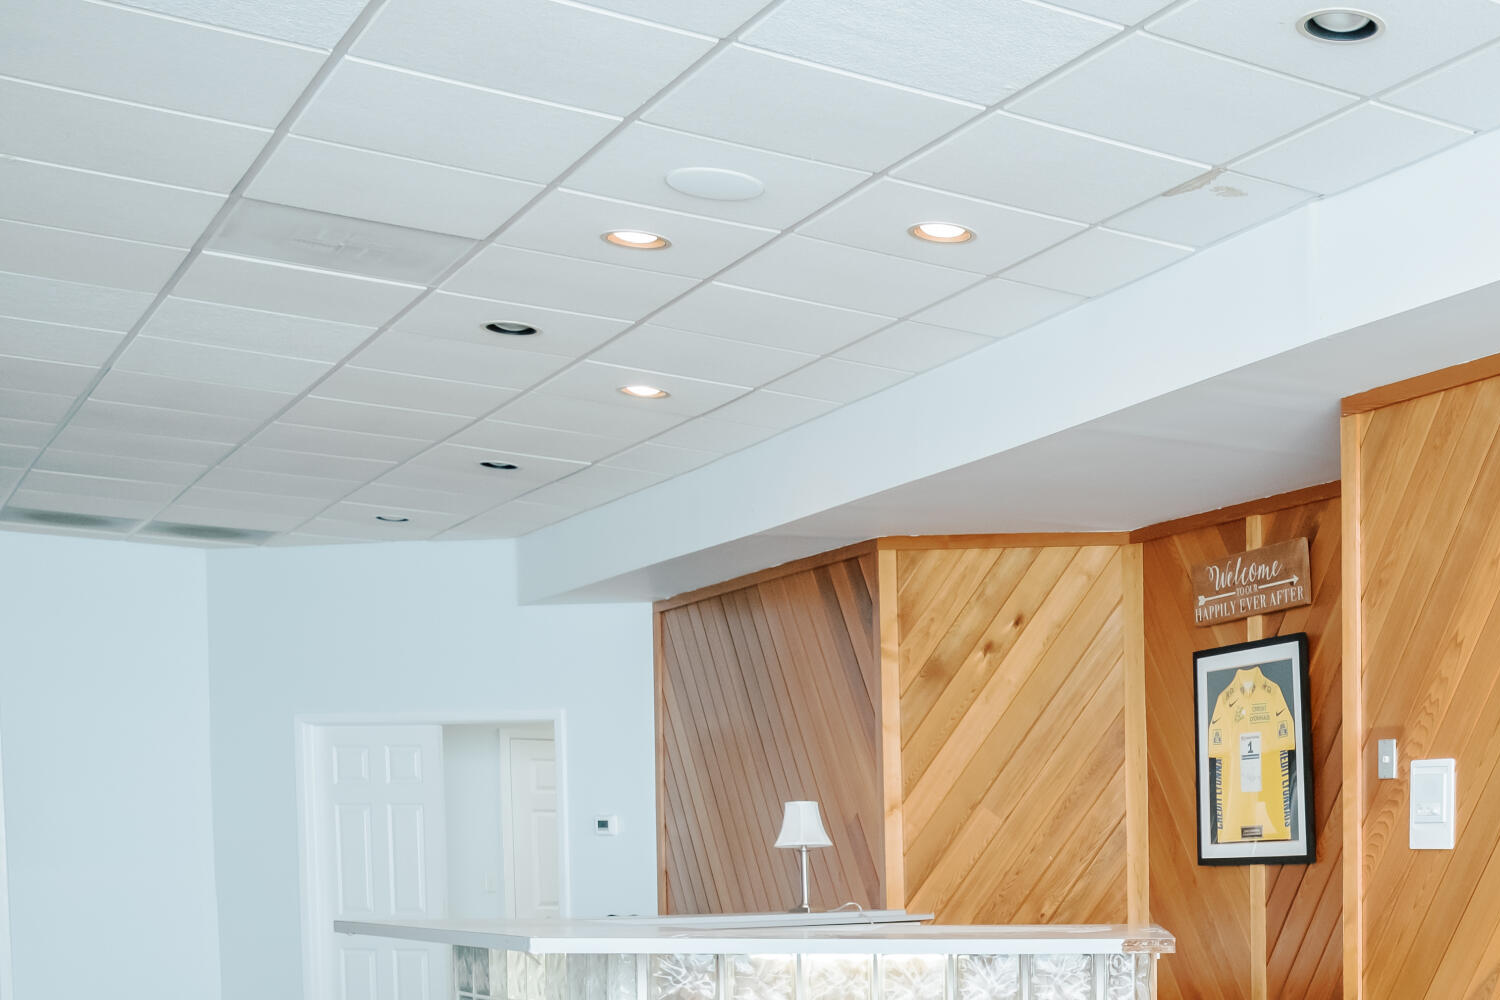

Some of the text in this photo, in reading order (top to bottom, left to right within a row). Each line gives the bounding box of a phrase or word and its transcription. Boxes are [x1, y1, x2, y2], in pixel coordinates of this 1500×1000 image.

[1206, 557, 1282, 590] Welcome
[1195, 586, 1304, 624] HAPPILY EVER AFTER
[1247, 740, 1254, 754] 1
